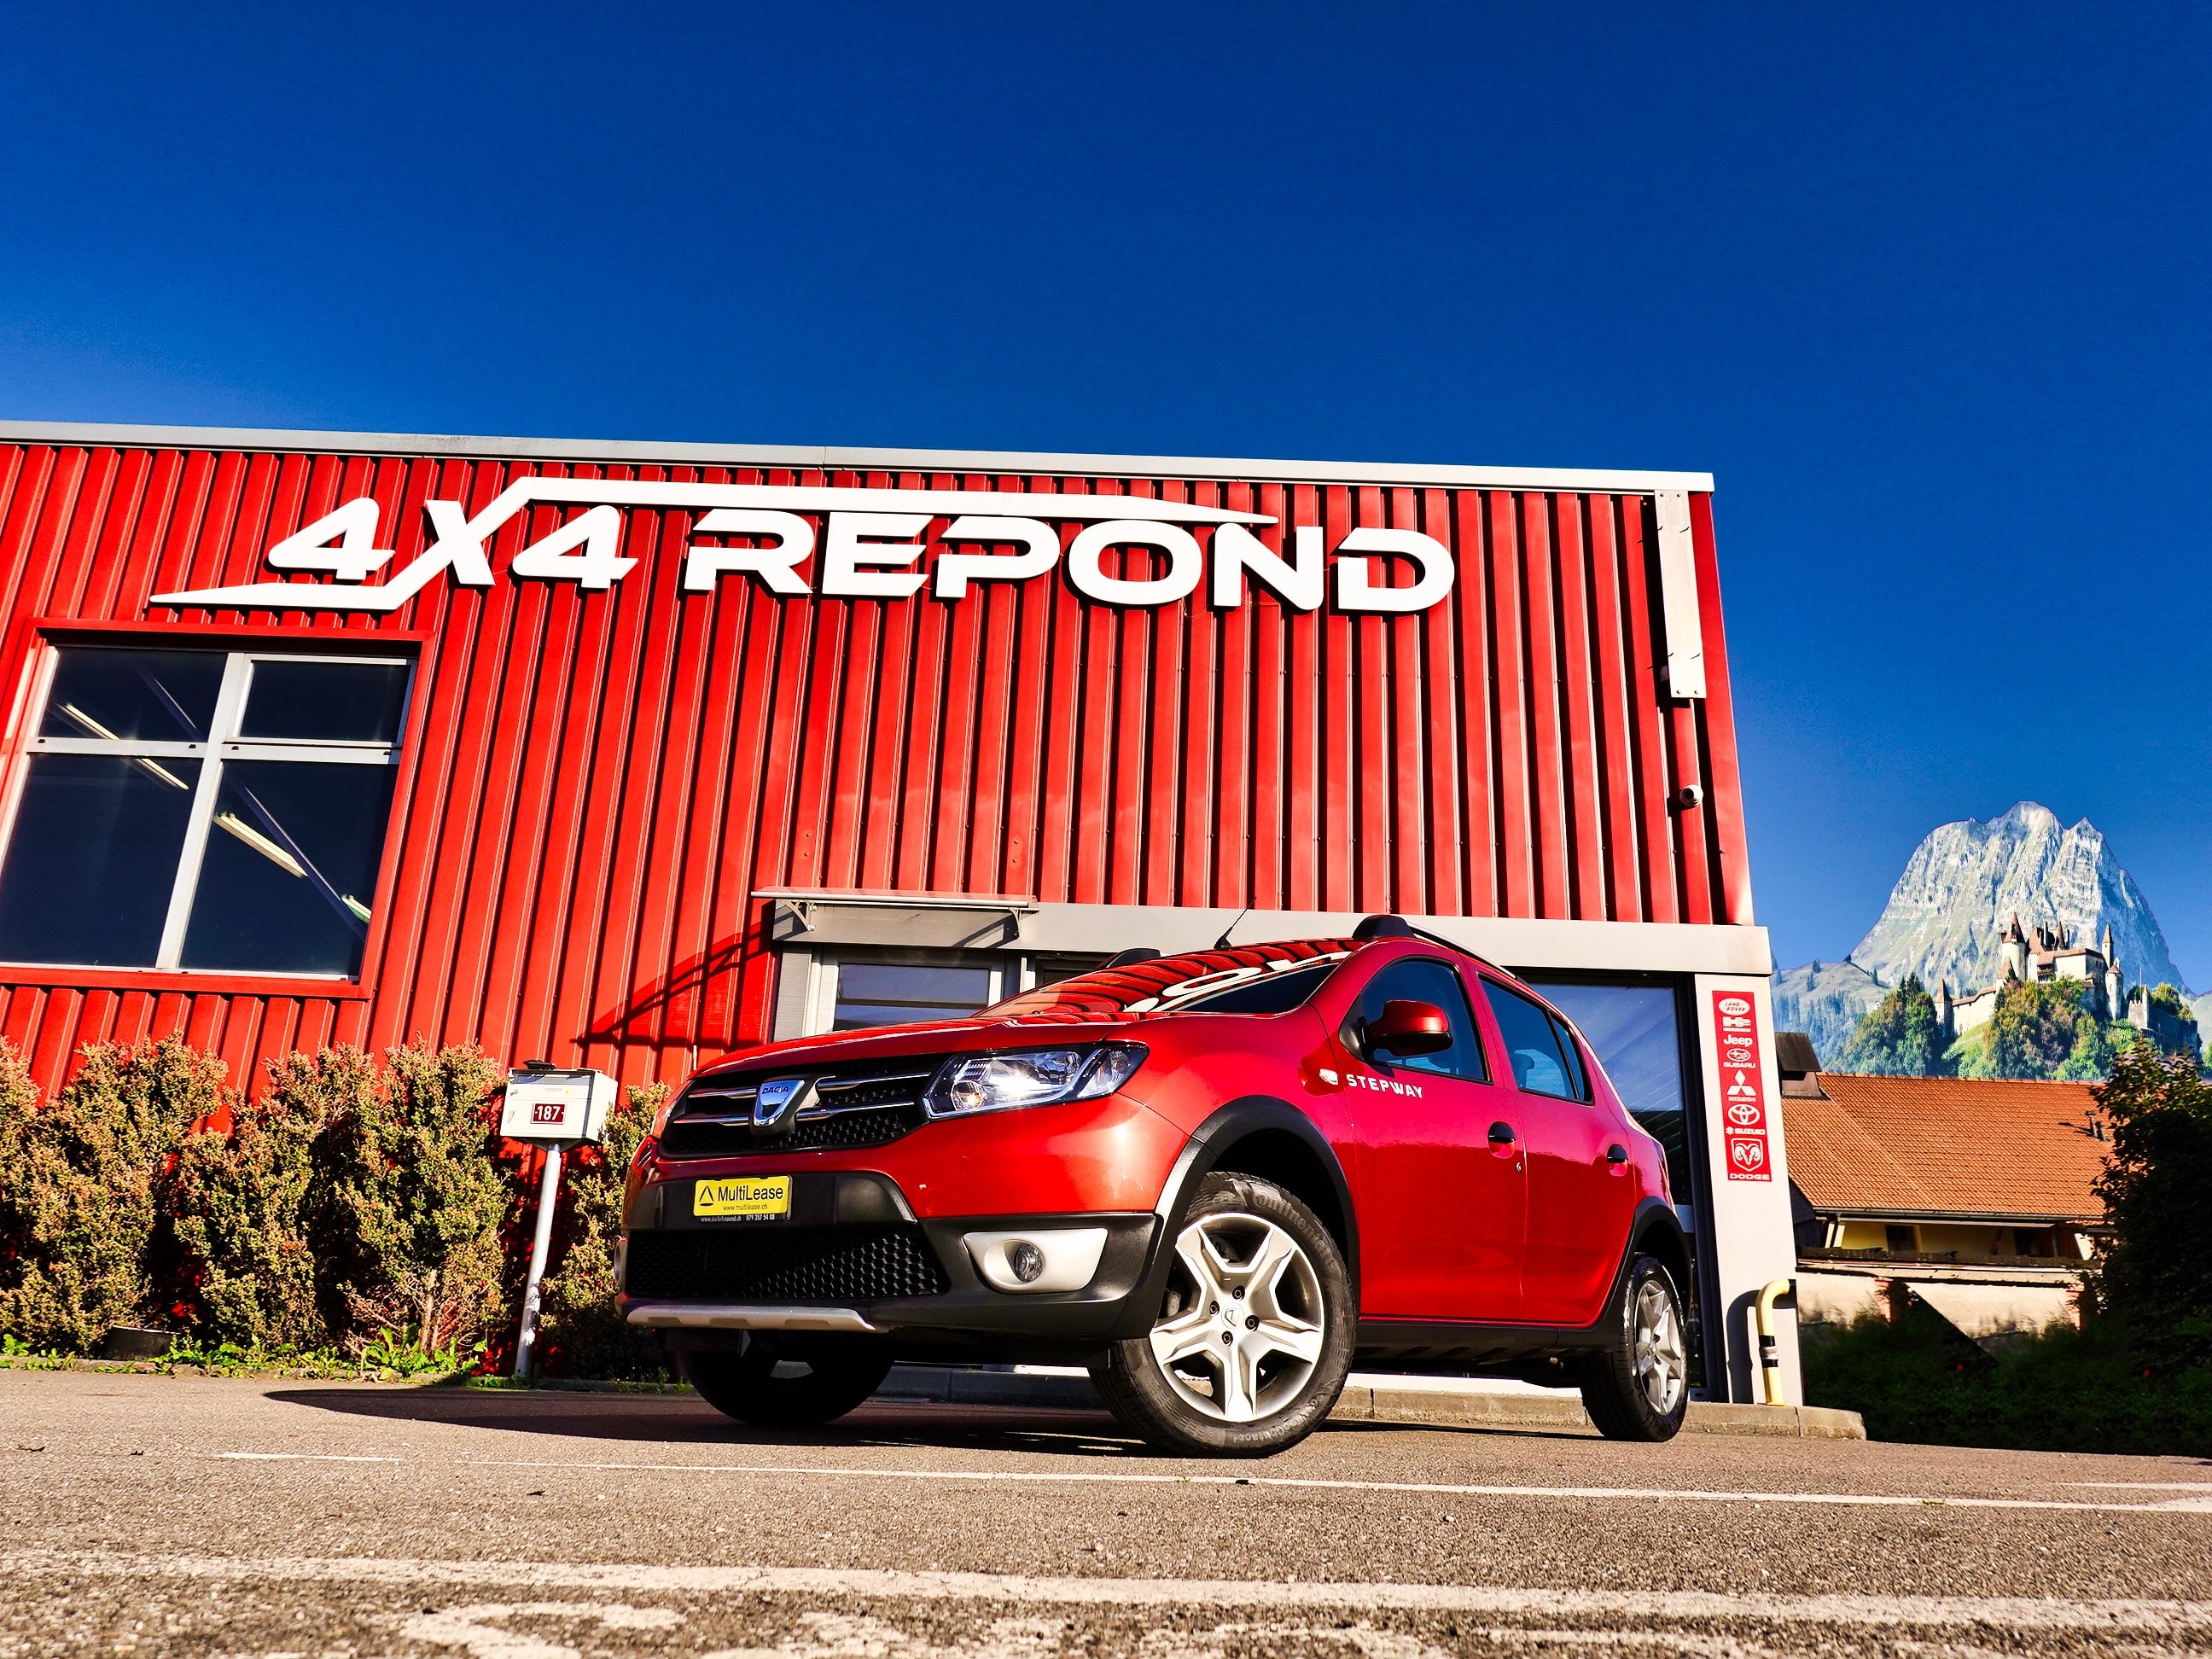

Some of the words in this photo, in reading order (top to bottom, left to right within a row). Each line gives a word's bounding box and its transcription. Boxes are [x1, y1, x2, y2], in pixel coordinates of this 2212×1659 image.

[267, 497, 638, 590] 4X4
[684, 509, 1456, 612] REPOND
[1723, 1034, 1753, 1048] Jeep
[1722, 1061, 1756, 1069] SUBARU
[762, 1086, 789, 1095] DACIA
[1346, 1074, 1423, 1098] STEPWAY
[537, 1105, 561, 1121] 187
[1729, 1173, 1771, 1181] DODGE
[718, 1185, 784, 1202] MultiLease
[723, 1203, 768, 1212] www.multilease.ch
